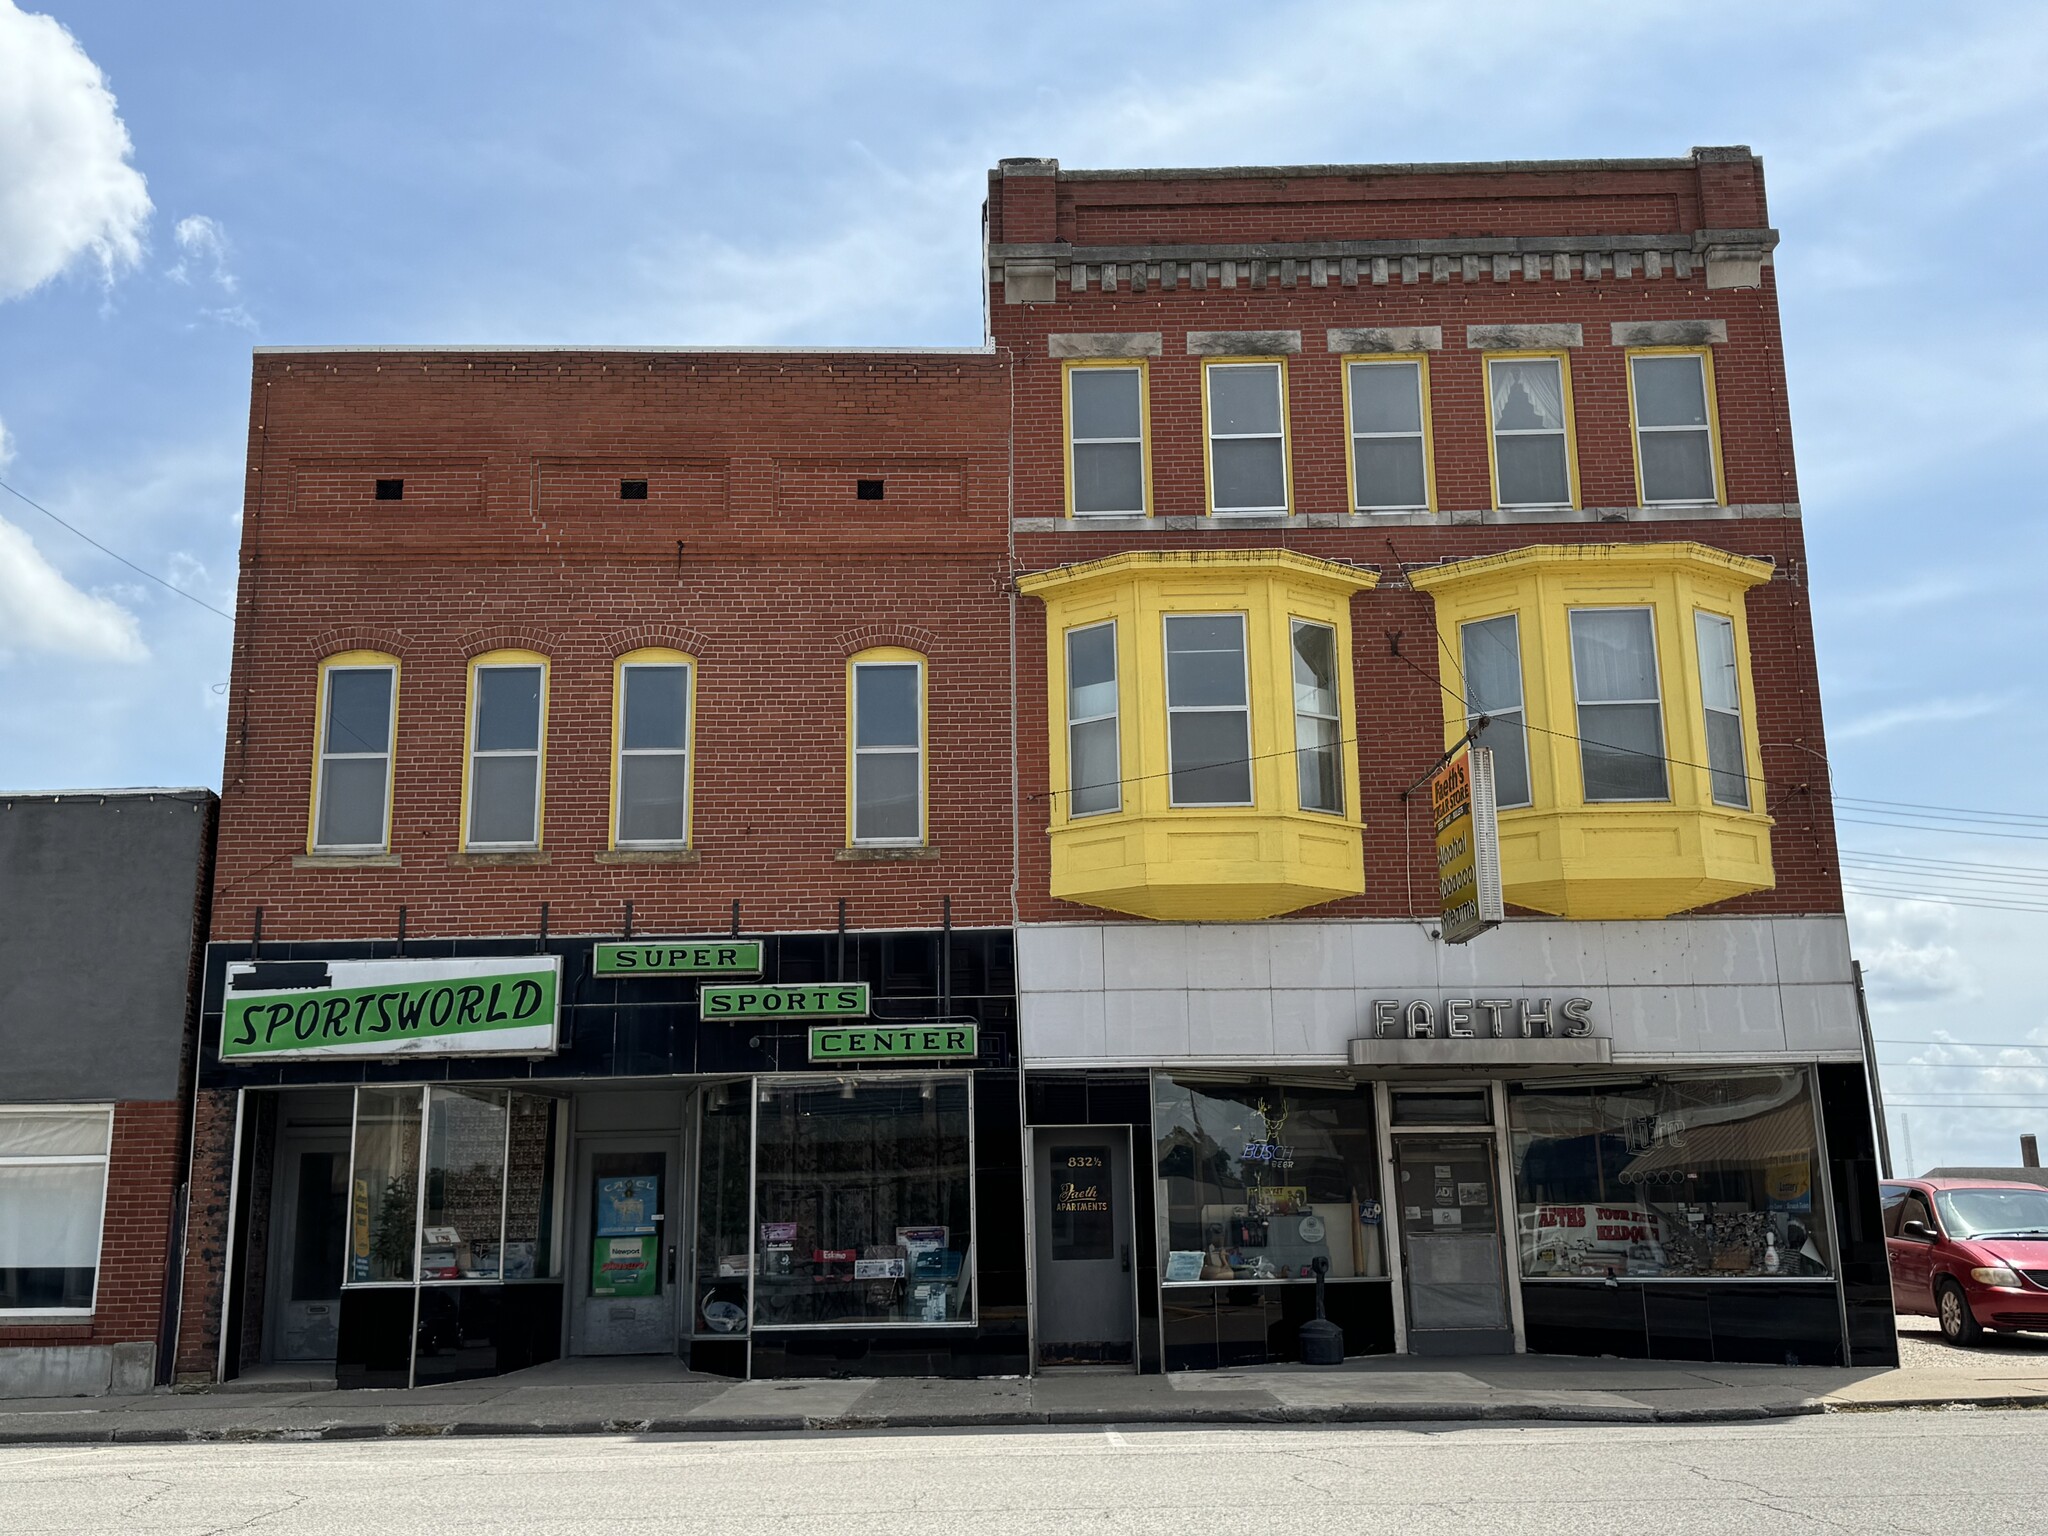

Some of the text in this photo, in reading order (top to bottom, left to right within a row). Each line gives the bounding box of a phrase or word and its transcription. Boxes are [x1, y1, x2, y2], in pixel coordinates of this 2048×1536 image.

[1434, 763, 1465, 804] Faeth's
[1450, 784, 1470, 810] STORE
[1438, 830, 1467, 868] Alcohol
[1439, 864, 1475, 900] Tobacco
[1441, 899, 1477, 931] Firearms
[616, 949, 737, 968] SUPER
[711, 992, 858, 1012] SPORTS
[232, 979, 543, 1046] SPORTSWORLD
[1370, 998, 1595, 1039] FAETHS
[821, 1031, 965, 1052] CENTER
[1623, 1115, 1688, 1157] Lite
[1241, 1143, 1295, 1160] BUSCH
[1271, 1160, 1295, 1169] BEER
[1435, 1187, 1453, 1198] ADT
[1056, 1202, 1108, 1212] APARTMENTS
[1596, 1208, 1630, 1221] YOUR
[612, 1247, 641, 1256] Newport
[823, 1250, 847, 1260] Eskimo
